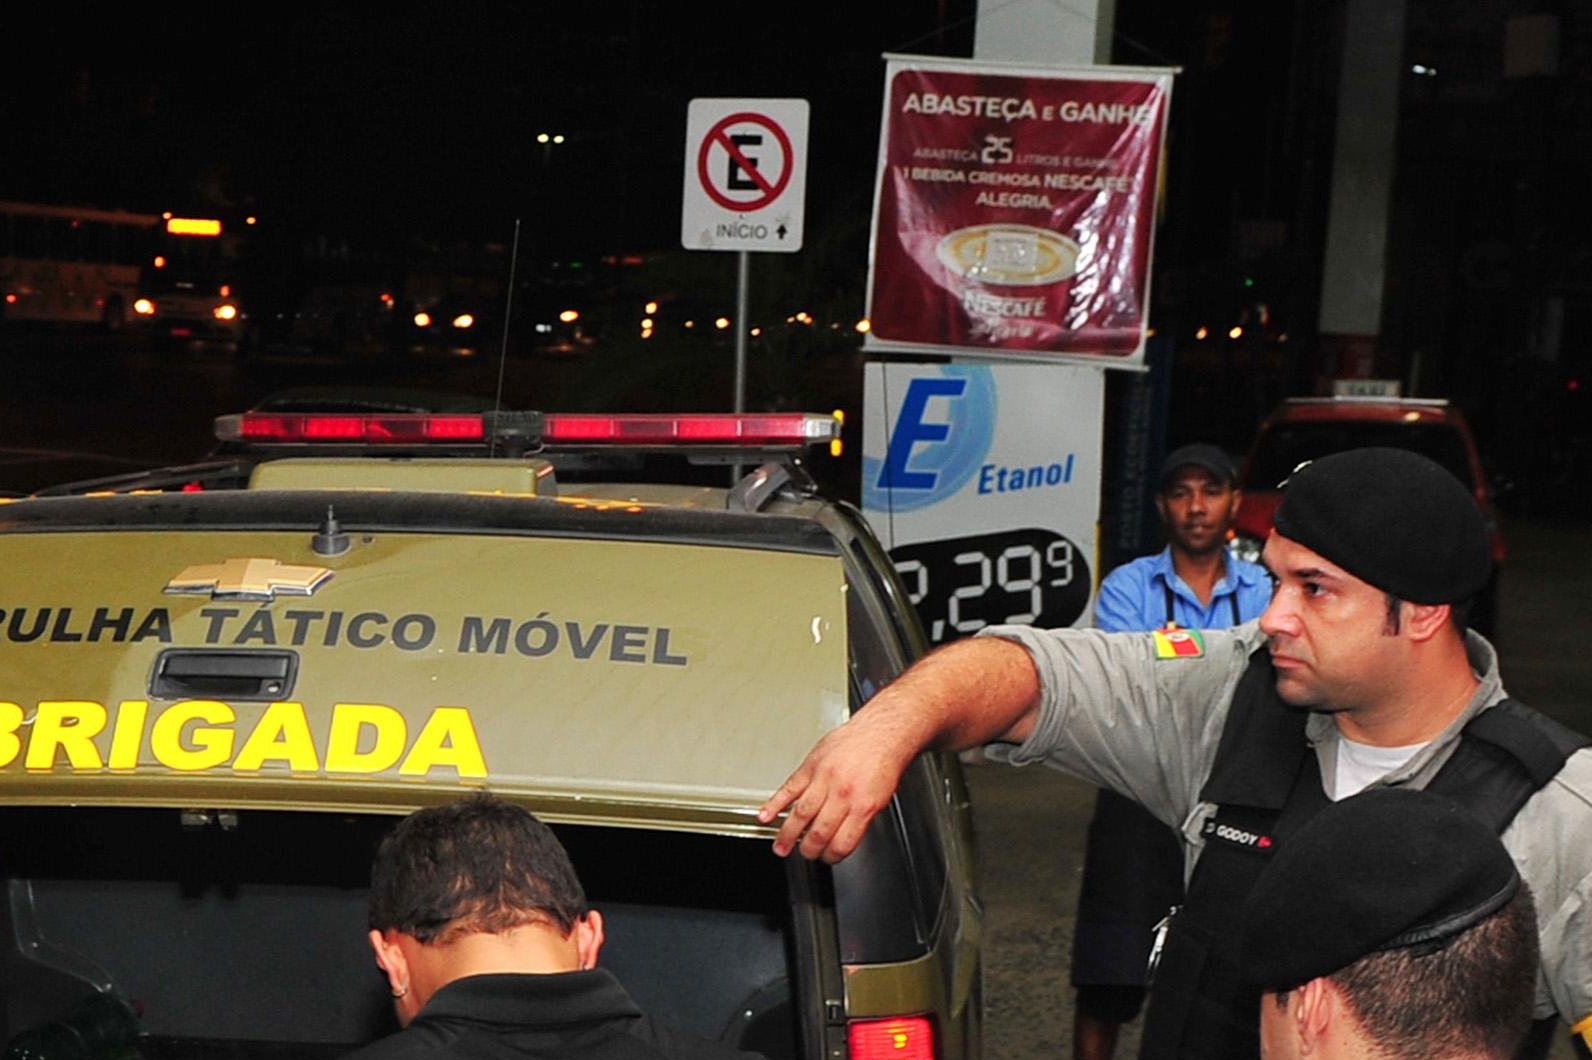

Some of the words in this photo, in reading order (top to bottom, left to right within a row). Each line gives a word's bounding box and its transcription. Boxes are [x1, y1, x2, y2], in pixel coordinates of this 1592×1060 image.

[902, 93, 1037, 122] ABASTEÇA
[1060, 101, 1151, 126] GANHE
[727, 134, 763, 190] E
[981, 135, 1013, 164] 25
[911, 168, 965, 183] BEBIDA
[968, 171, 1041, 188] CREMOSA
[716, 221, 768, 239] INÍCIO
[875, 379, 968, 489] E
[977, 453, 1074, 495] Etanol
[198, 603, 438, 652] TÁTICO
[457, 612, 689, 667] MÓVEL
